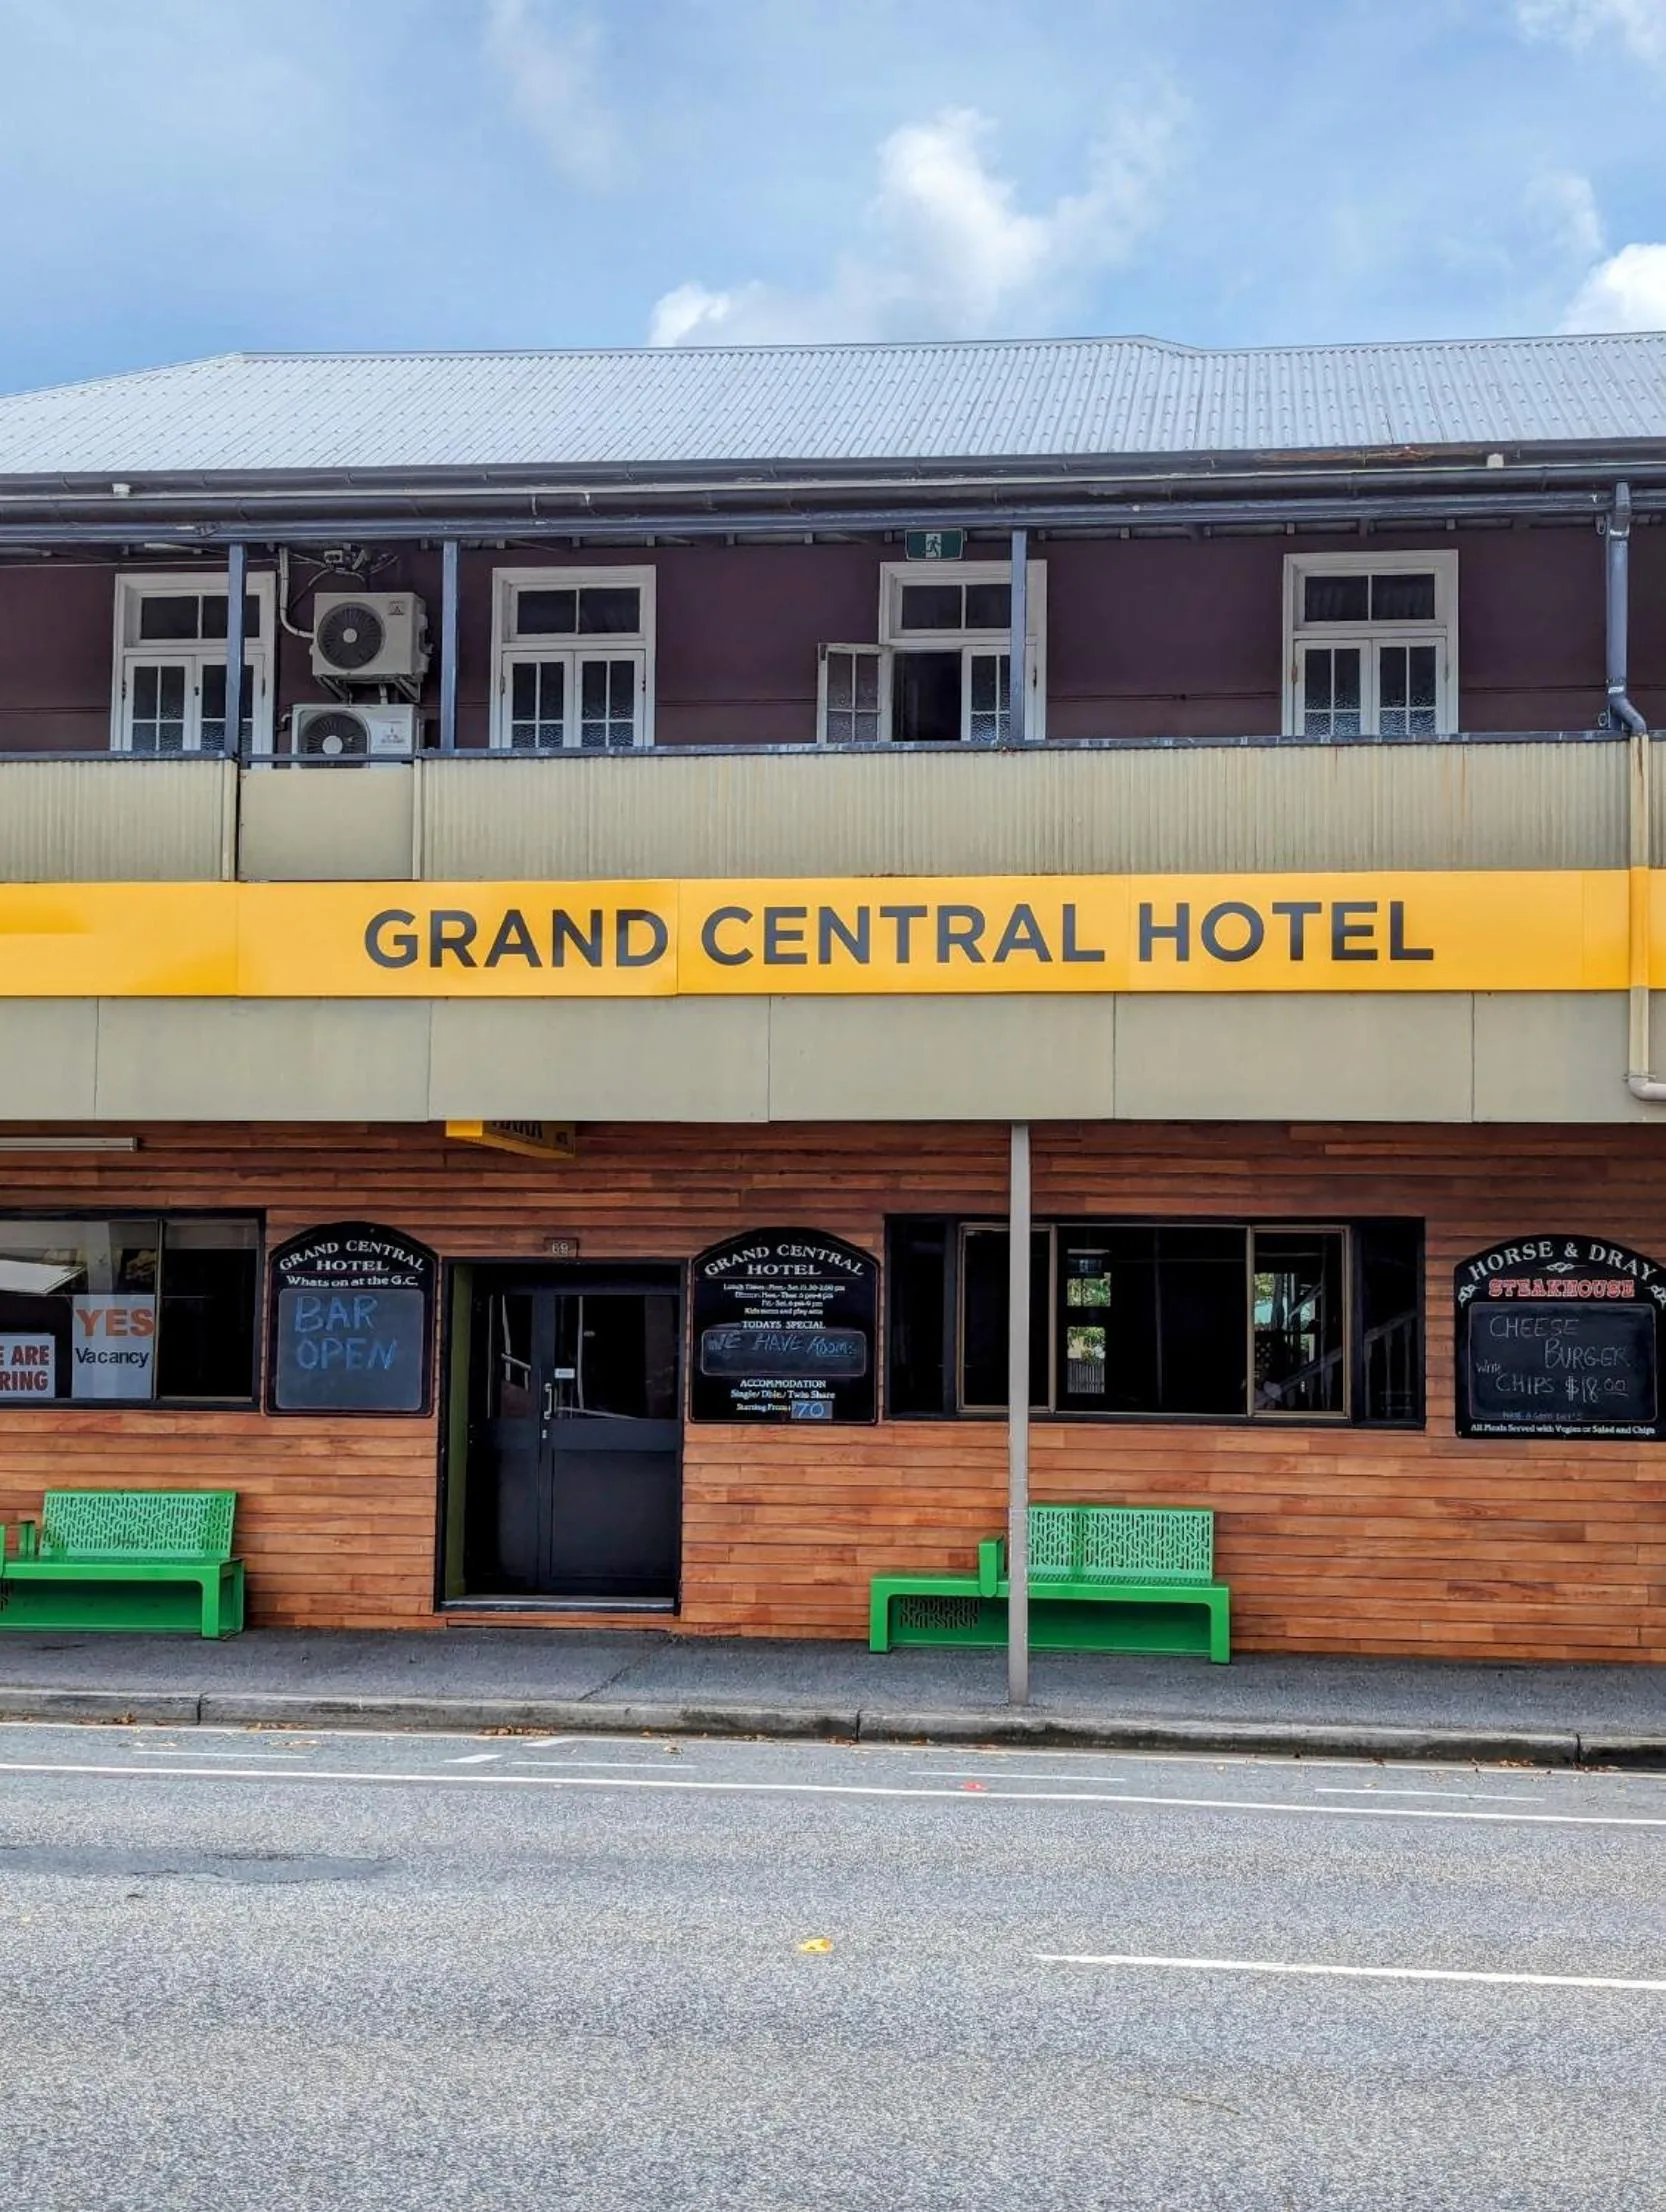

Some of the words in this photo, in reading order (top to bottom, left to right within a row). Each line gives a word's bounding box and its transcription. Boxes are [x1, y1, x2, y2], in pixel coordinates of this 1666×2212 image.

[364, 908, 668, 968] GRAND
[701, 903, 1105, 966] CENTRAL
[1139, 901, 1434, 962] HOTEL
[279, 1242, 339, 1271] GRAND
[345, 1240, 424, 1271] CENTRAL
[316, 1260, 390, 1272] HOTEL
[704, 1246, 769, 1276] GRAND
[776, 1244, 864, 1276] CENTRAL
[1468, 1241, 1554, 1281] HORSE
[1564, 1242, 1579, 1258] &
[1588, 1244, 1659, 1282] DRAY
[746, 1263, 822, 1276] HOTEL
[286, 1275, 330, 1287] Whats
[331, 1277, 349, 1287] on
[350, 1276, 365, 1287] at
[367, 1275, 389, 1286] the
[1488, 1278, 1635, 1298] STEAKHOUSE
[76, 1308, 155, 1337] YES
[294, 1295, 378, 1333] BAR
[742, 1320, 782, 1329] TODAYS
[785, 1320, 826, 1329] SPECIAL
[1489, 1315, 1580, 1338] CHEESE
[296, 1337, 398, 1370] OPEN
[752, 1334, 803, 1353] HAVE
[1544, 1338, 1630, 1370] BURGER
[11, 1345, 49, 1365] ARE
[75, 1347, 150, 1368] Vacancy
[740, 1379, 826, 1389] ACCOMMODATION
[1496, 1374, 1555, 1395] CHIPS
[796, 1402, 824, 1418] 70
[1470, 1423, 1483, 1433] All
